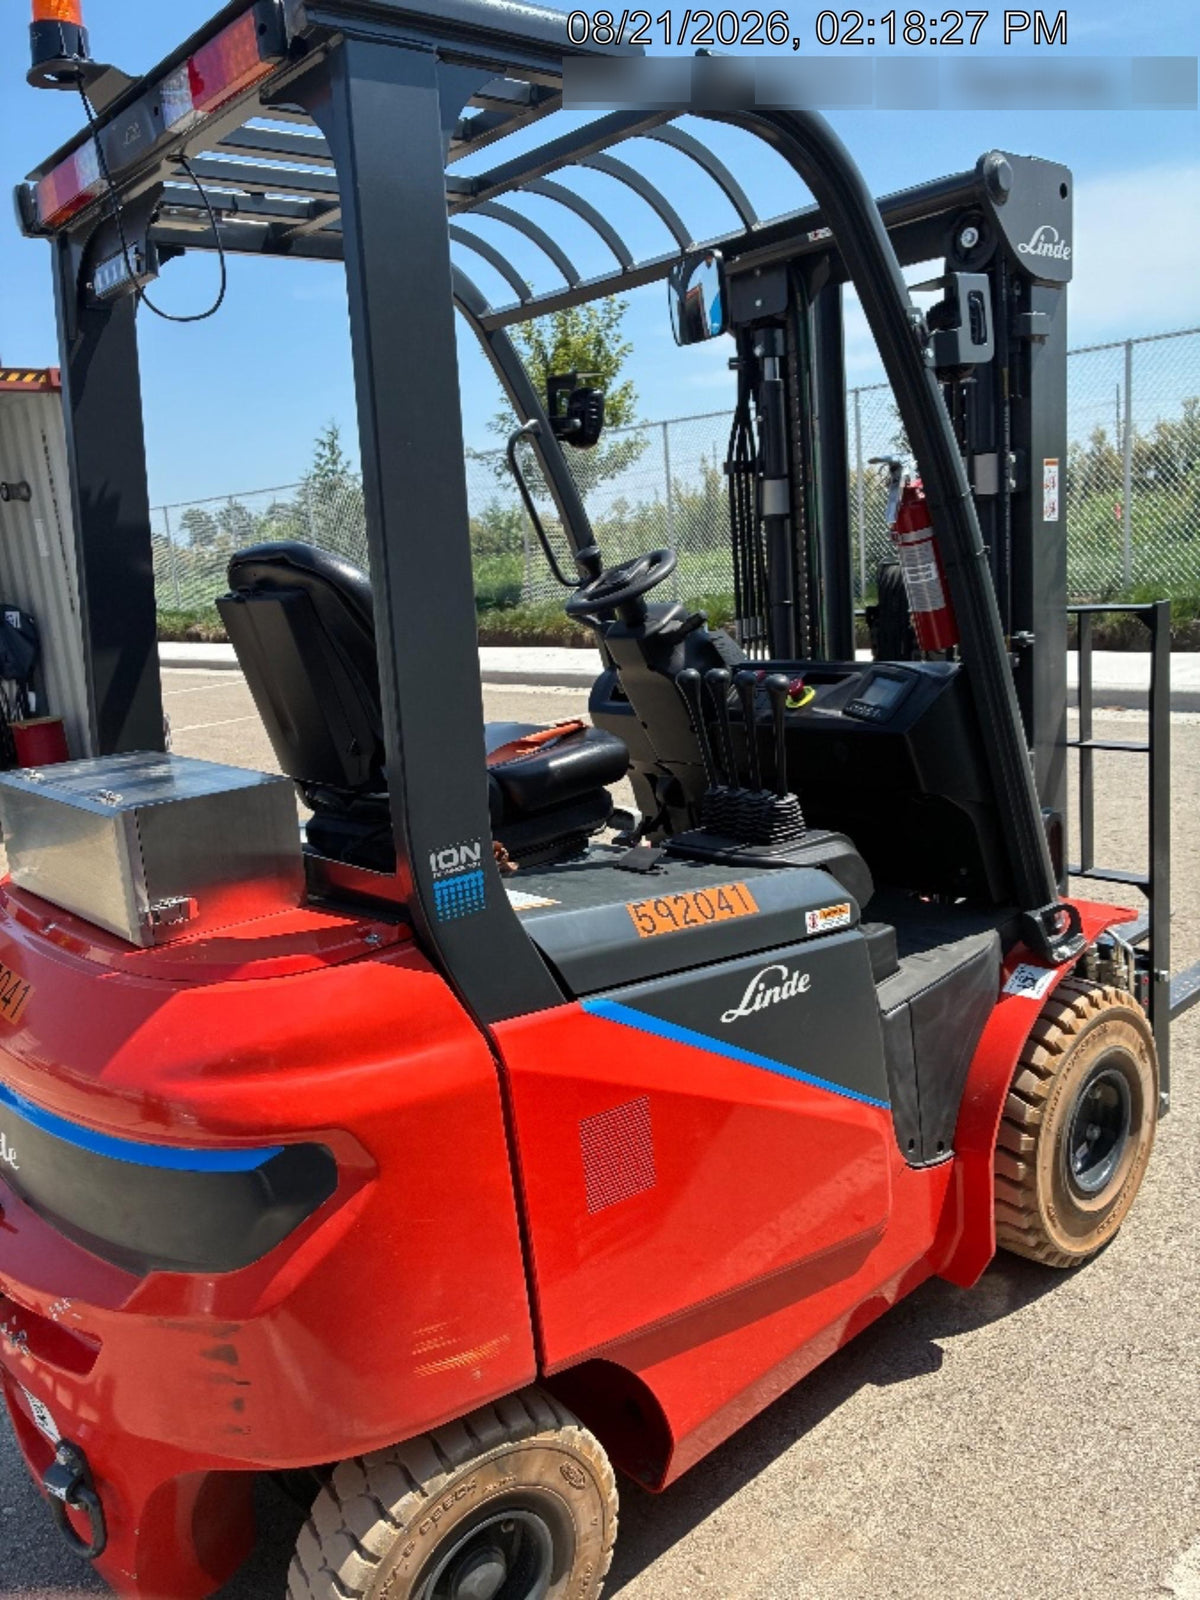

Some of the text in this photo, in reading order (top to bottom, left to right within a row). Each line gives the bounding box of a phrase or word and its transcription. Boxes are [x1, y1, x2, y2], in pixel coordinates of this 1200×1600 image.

[1018, 225, 1071, 260] Linde
[429, 842, 481, 872] ION
[632, 884, 749, 934] 592041
[0, 963, 31, 1018] 041
[720, 965, 812, 1023] Linde
